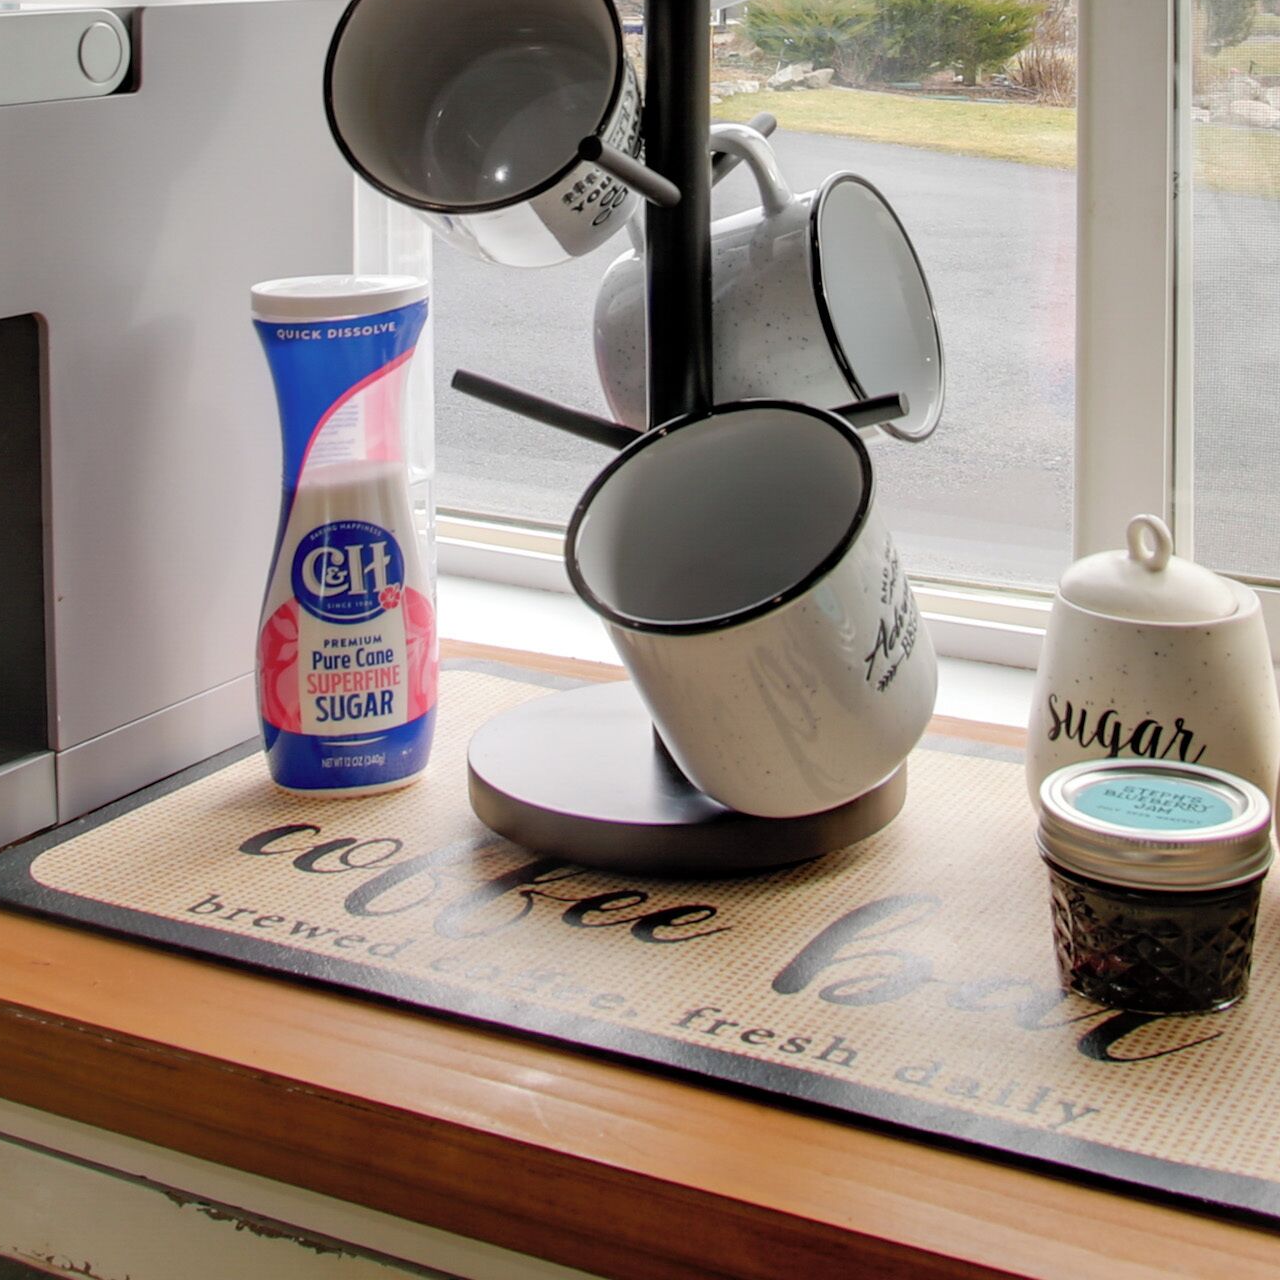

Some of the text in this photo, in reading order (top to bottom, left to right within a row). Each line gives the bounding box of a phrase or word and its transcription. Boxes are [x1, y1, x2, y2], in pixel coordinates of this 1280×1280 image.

[276, 321, 396, 340] QUICK DISSOLVE
[302, 541, 391, 598] C&H
[327, 602, 353, 610] SINCE
[323, 634, 383, 649] PREMIUM
[311, 647, 394, 671] Pure Cane
[306, 664, 401, 695] SUPERFINE
[314, 689, 394, 723] SUGAR
[1047, 692, 1207, 763] sugar
[352, 755, 363, 767] OZ
[1104, 789, 1214, 814] BLUEBERRY
[1123, 785, 1204, 804] STEPH'S
[1133, 803, 1173, 816] JAM
[238, 822, 733, 944] coffee
[186, 893, 417, 960] brewed
[671, 1006, 858, 1069] fresh
[894, 1059, 1101, 1130] daily
